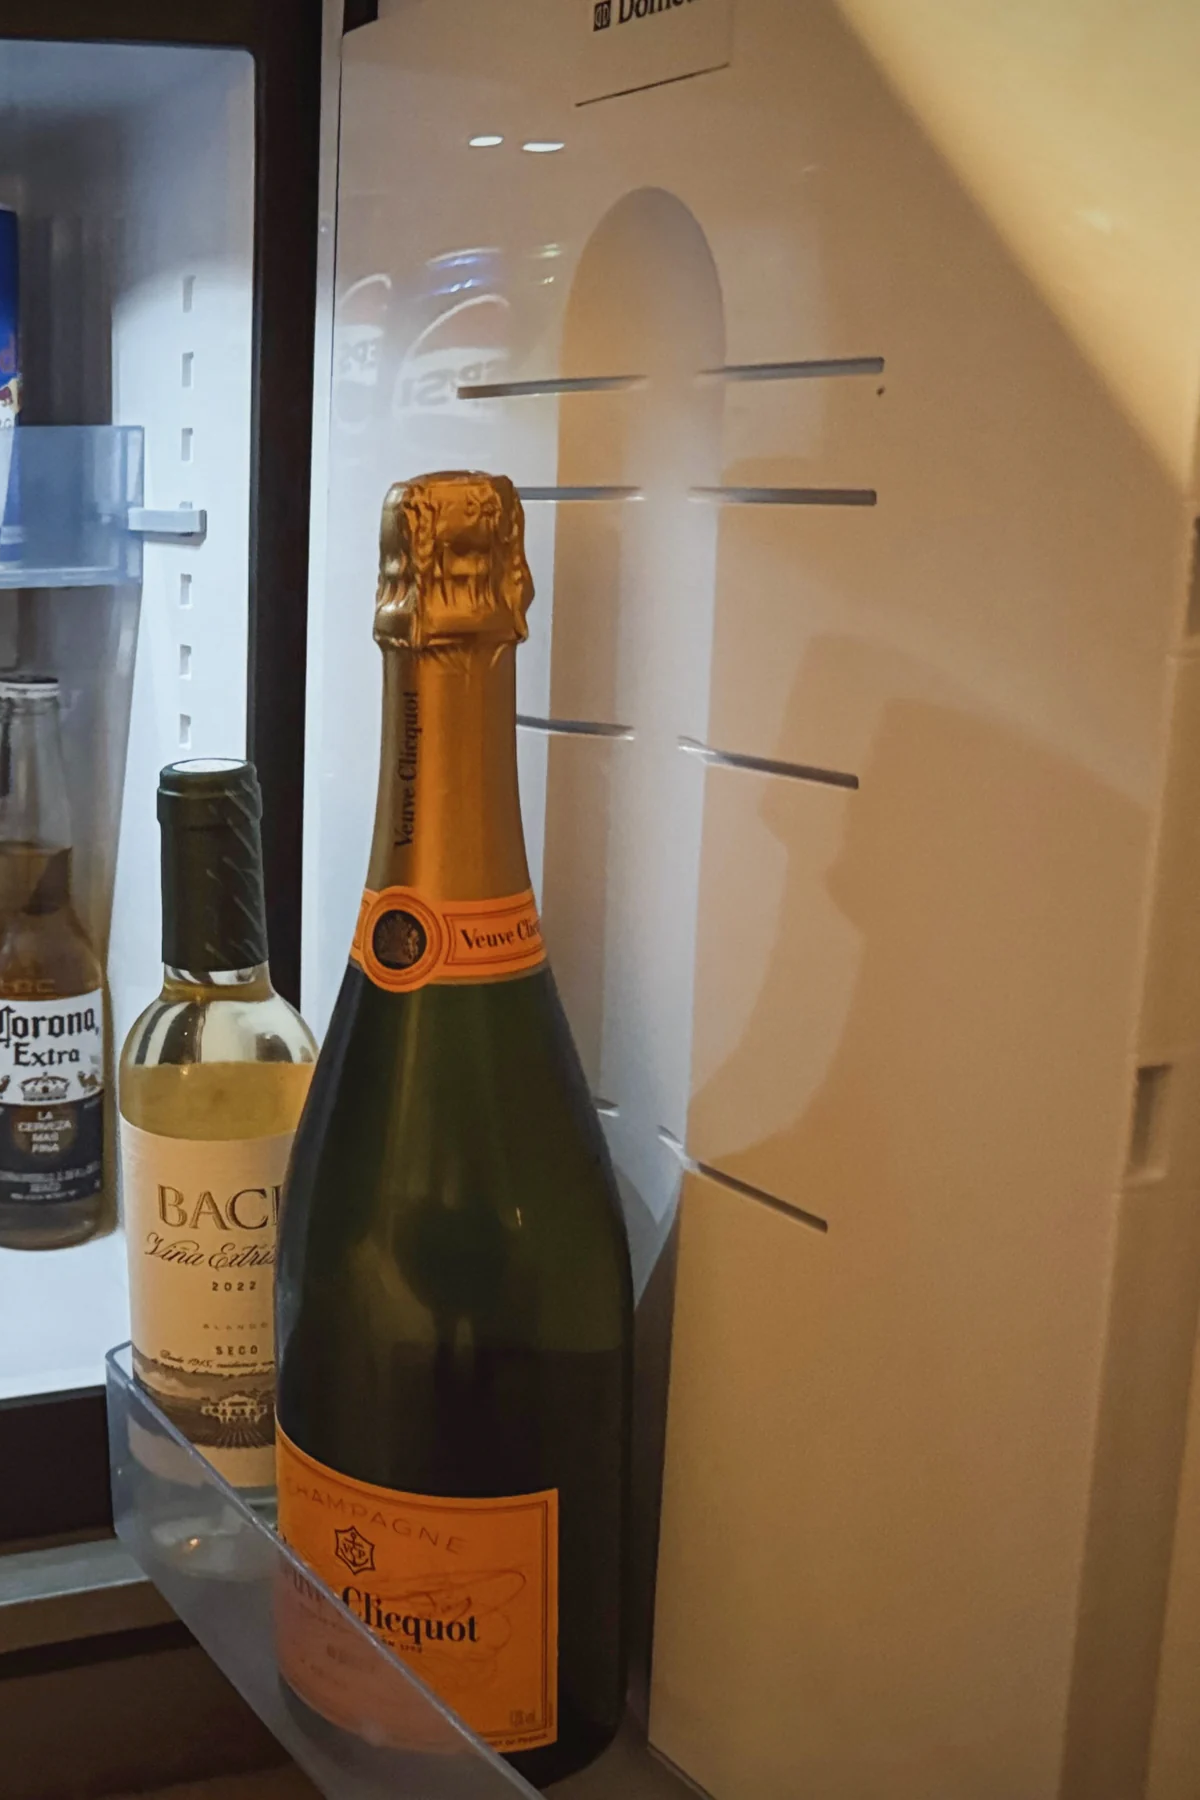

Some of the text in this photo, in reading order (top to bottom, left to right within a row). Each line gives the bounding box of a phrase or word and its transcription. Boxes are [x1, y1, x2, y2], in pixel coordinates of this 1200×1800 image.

[461, 926, 513, 951] Veuve
[13, 1041, 80, 1067] Extra
[37, 1111, 53, 1120] LA
[212, 1281, 257, 1292] 2022
[216, 1345, 258, 1357] SECO
[285, 1477, 469, 1555] CHAMPAGNE
[341, 1586, 480, 1646] Clicquot
